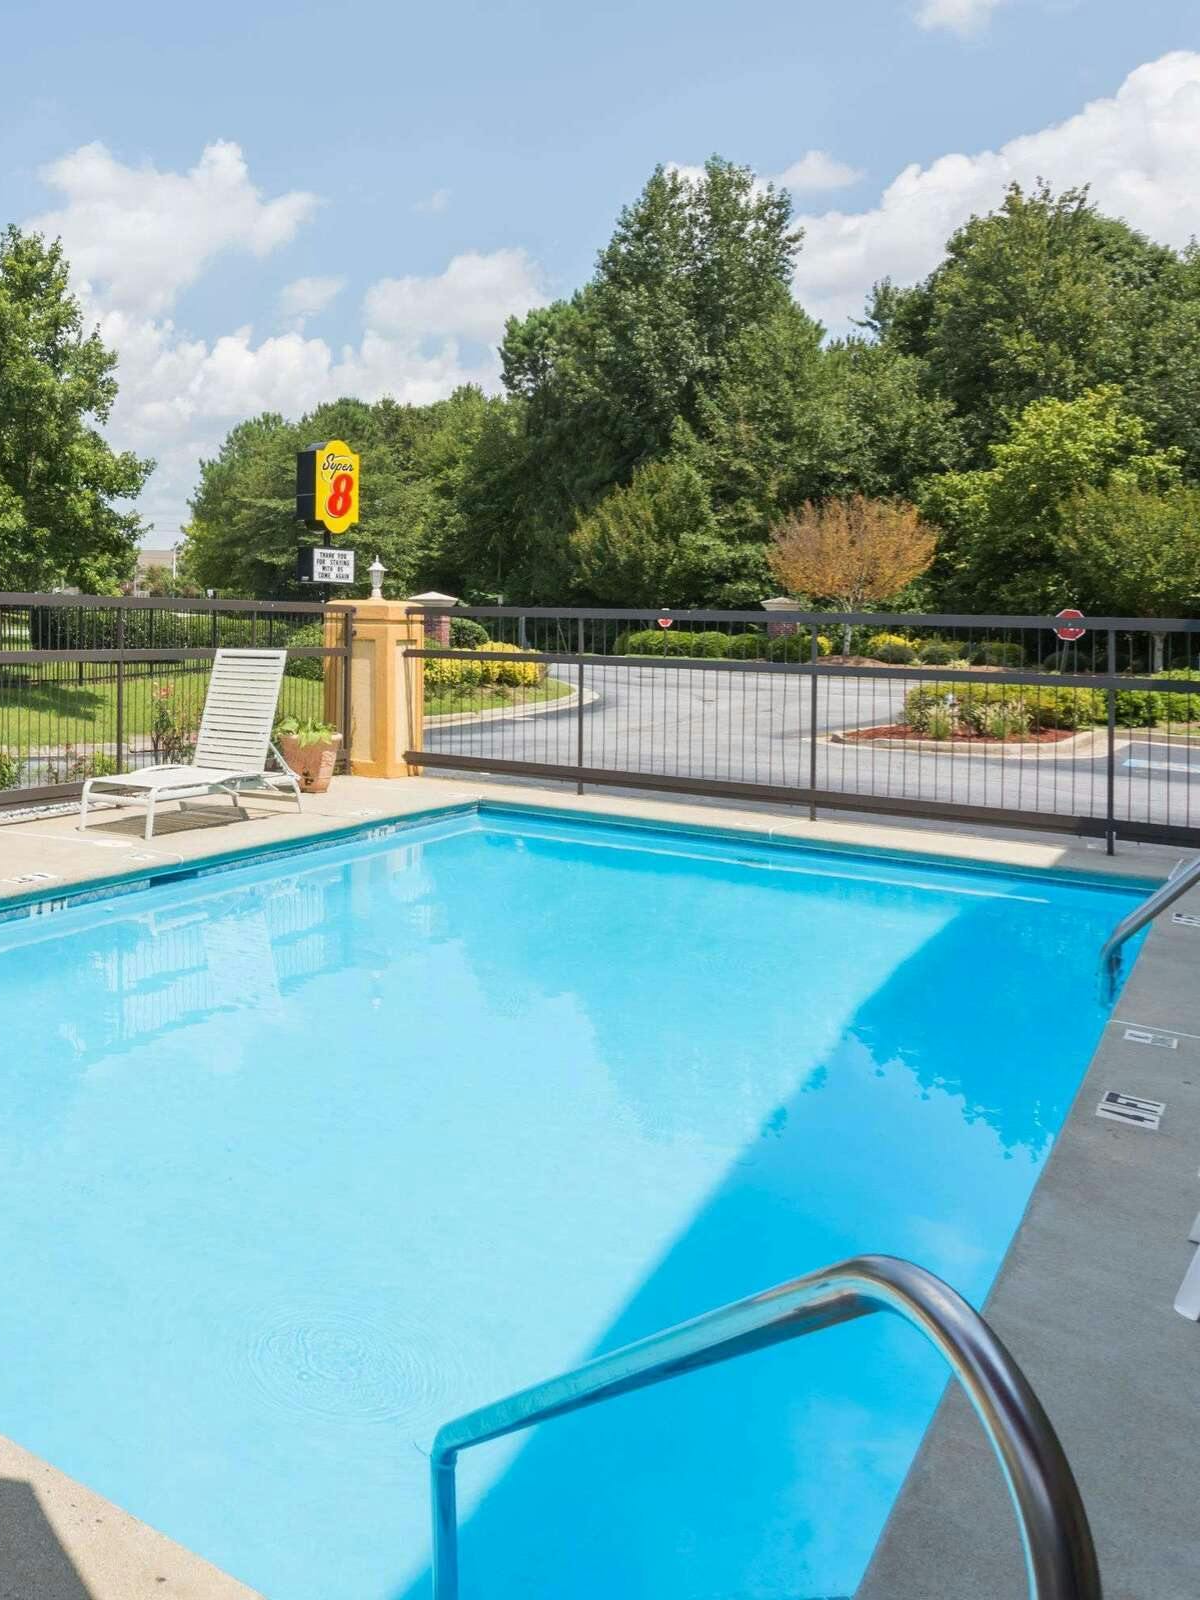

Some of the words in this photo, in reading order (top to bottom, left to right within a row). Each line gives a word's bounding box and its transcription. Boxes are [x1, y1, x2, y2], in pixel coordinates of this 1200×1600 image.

[322, 453, 354, 480] Super
[327, 473, 354, 518] 8
[1105, 1091, 1161, 1113] FT
[1099, 1107, 1156, 1122] 4
